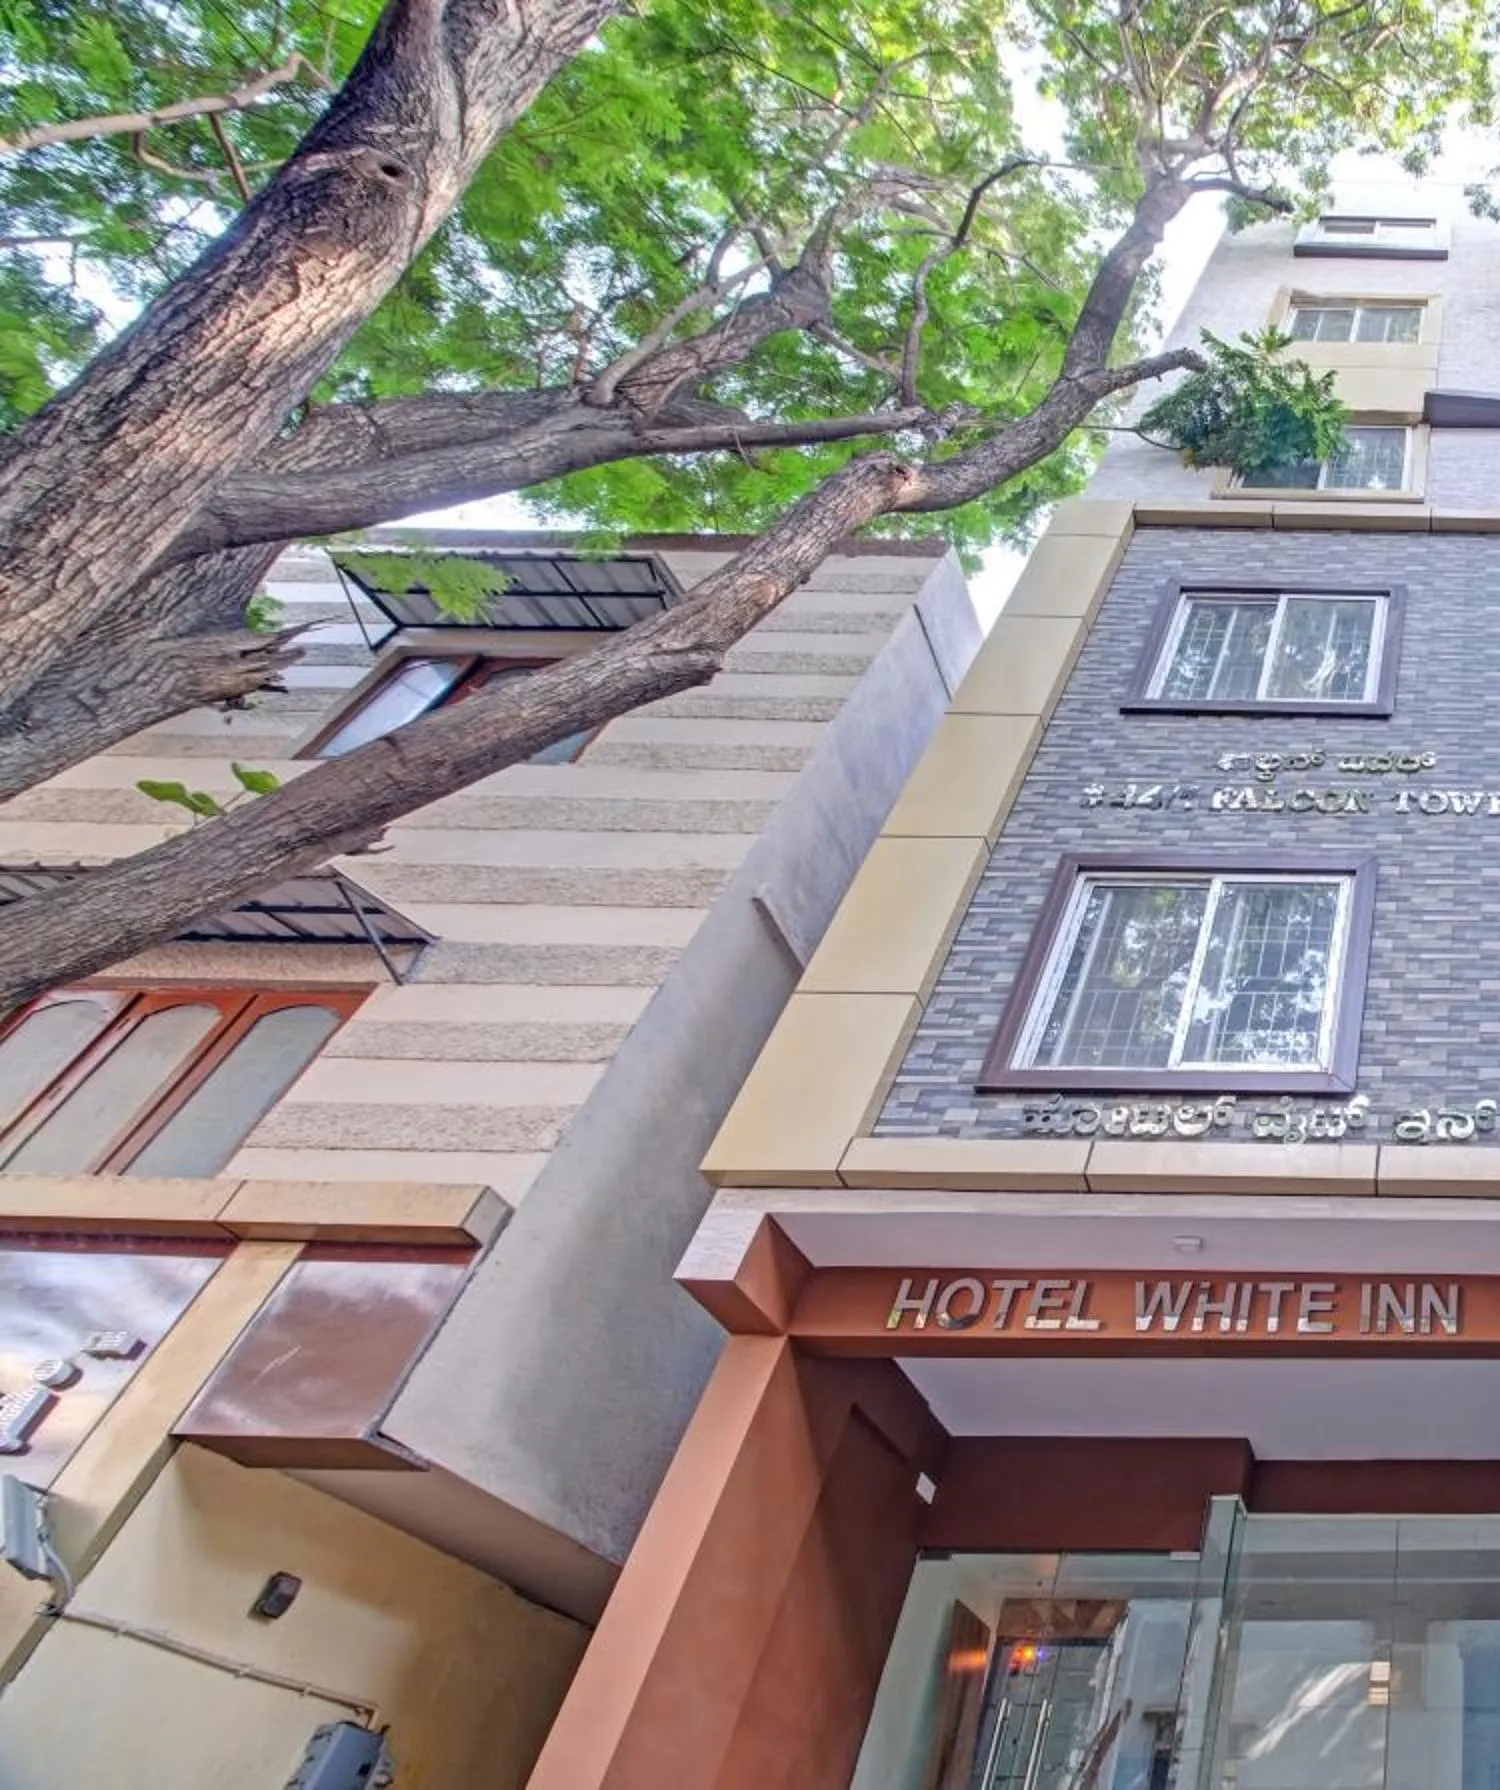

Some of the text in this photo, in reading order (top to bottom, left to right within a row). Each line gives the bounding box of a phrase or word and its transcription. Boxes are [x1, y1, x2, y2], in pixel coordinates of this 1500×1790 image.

[1209, 786, 1370, 813] FALCON
[885, 1278, 1460, 1335] HOTEL WHITE INN
